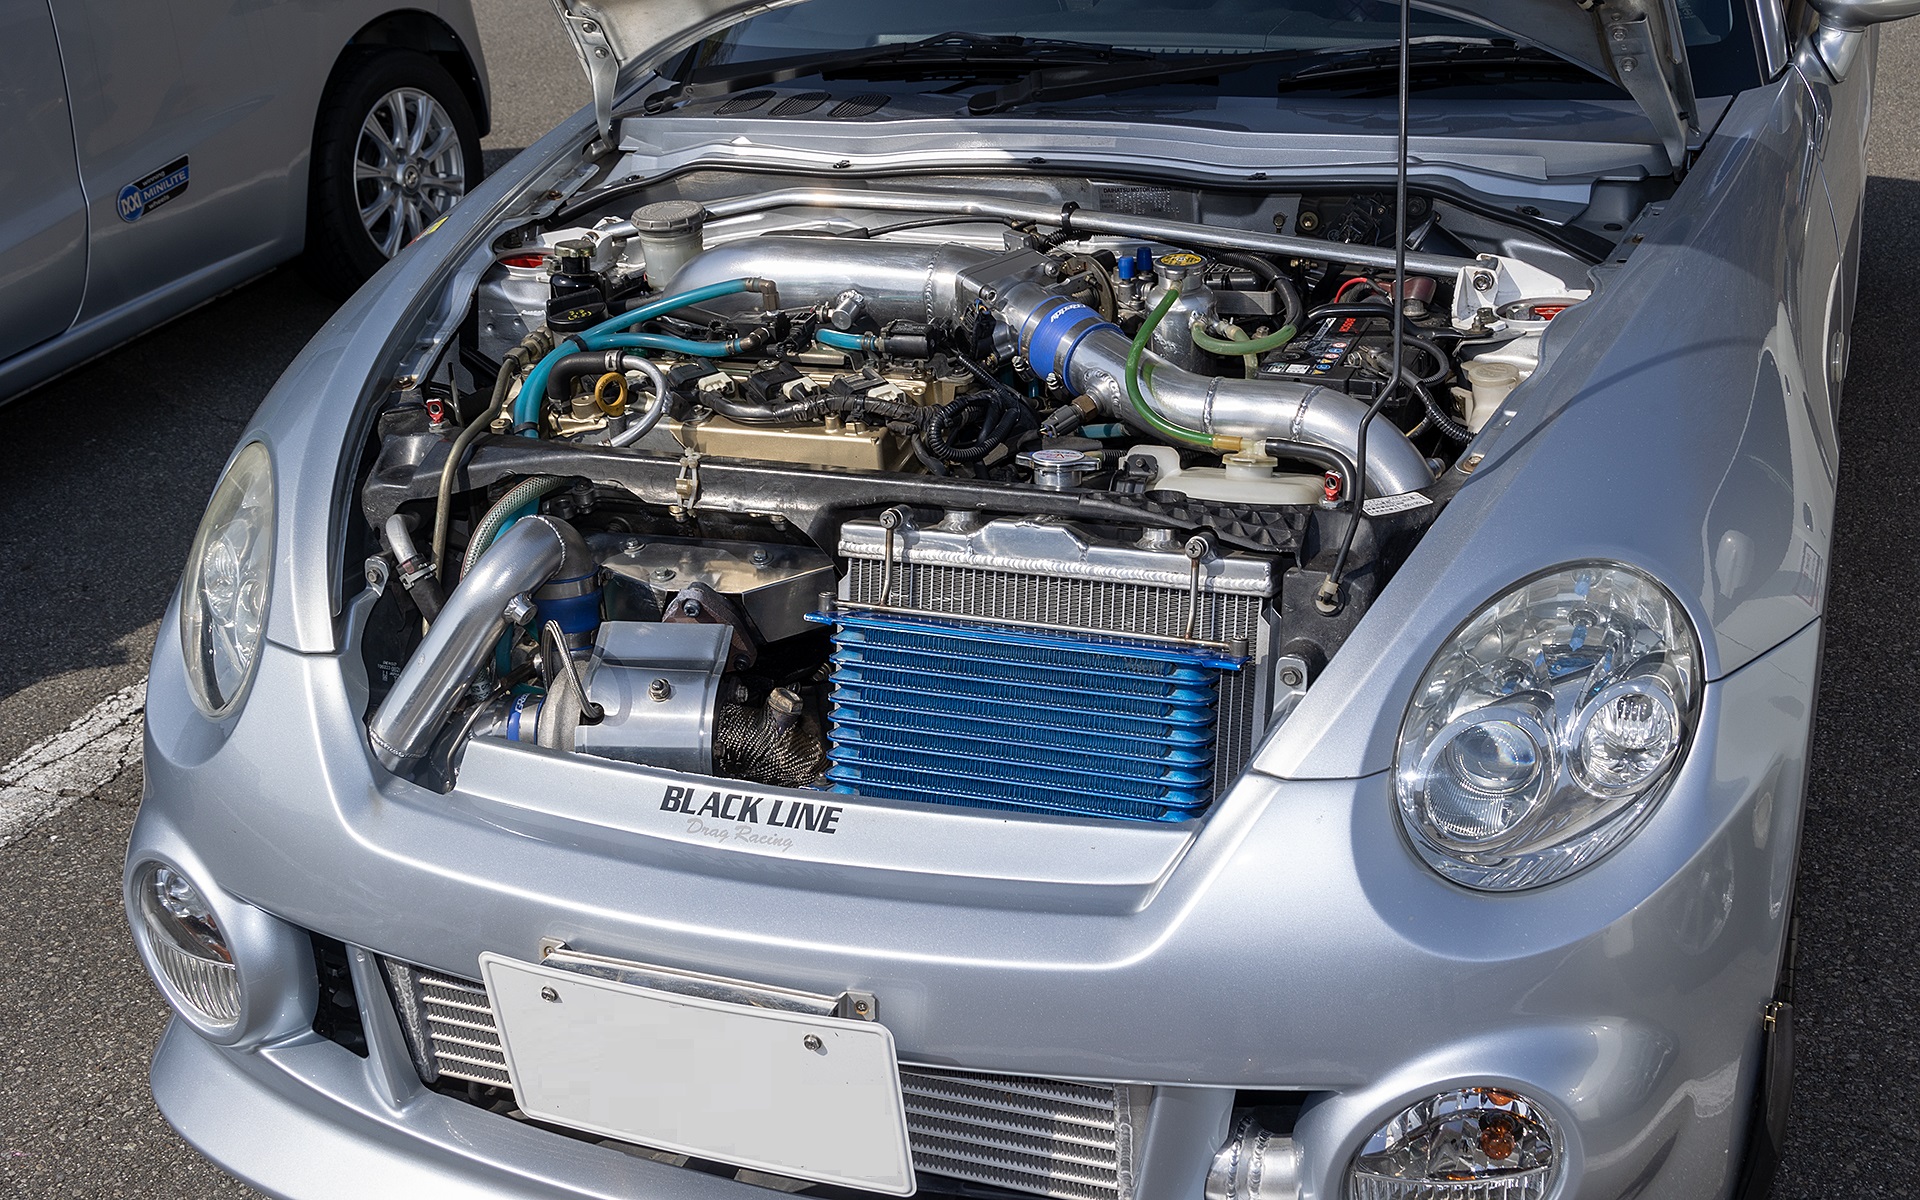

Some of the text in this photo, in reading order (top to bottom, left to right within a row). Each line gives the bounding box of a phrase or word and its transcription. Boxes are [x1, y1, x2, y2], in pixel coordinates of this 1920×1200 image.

[142, 170, 166, 186] winning
[143, 170, 187, 200] MINILITE
[659, 785, 843, 834] BLACK LINE
[686, 817, 794, 852] Drag Racing
